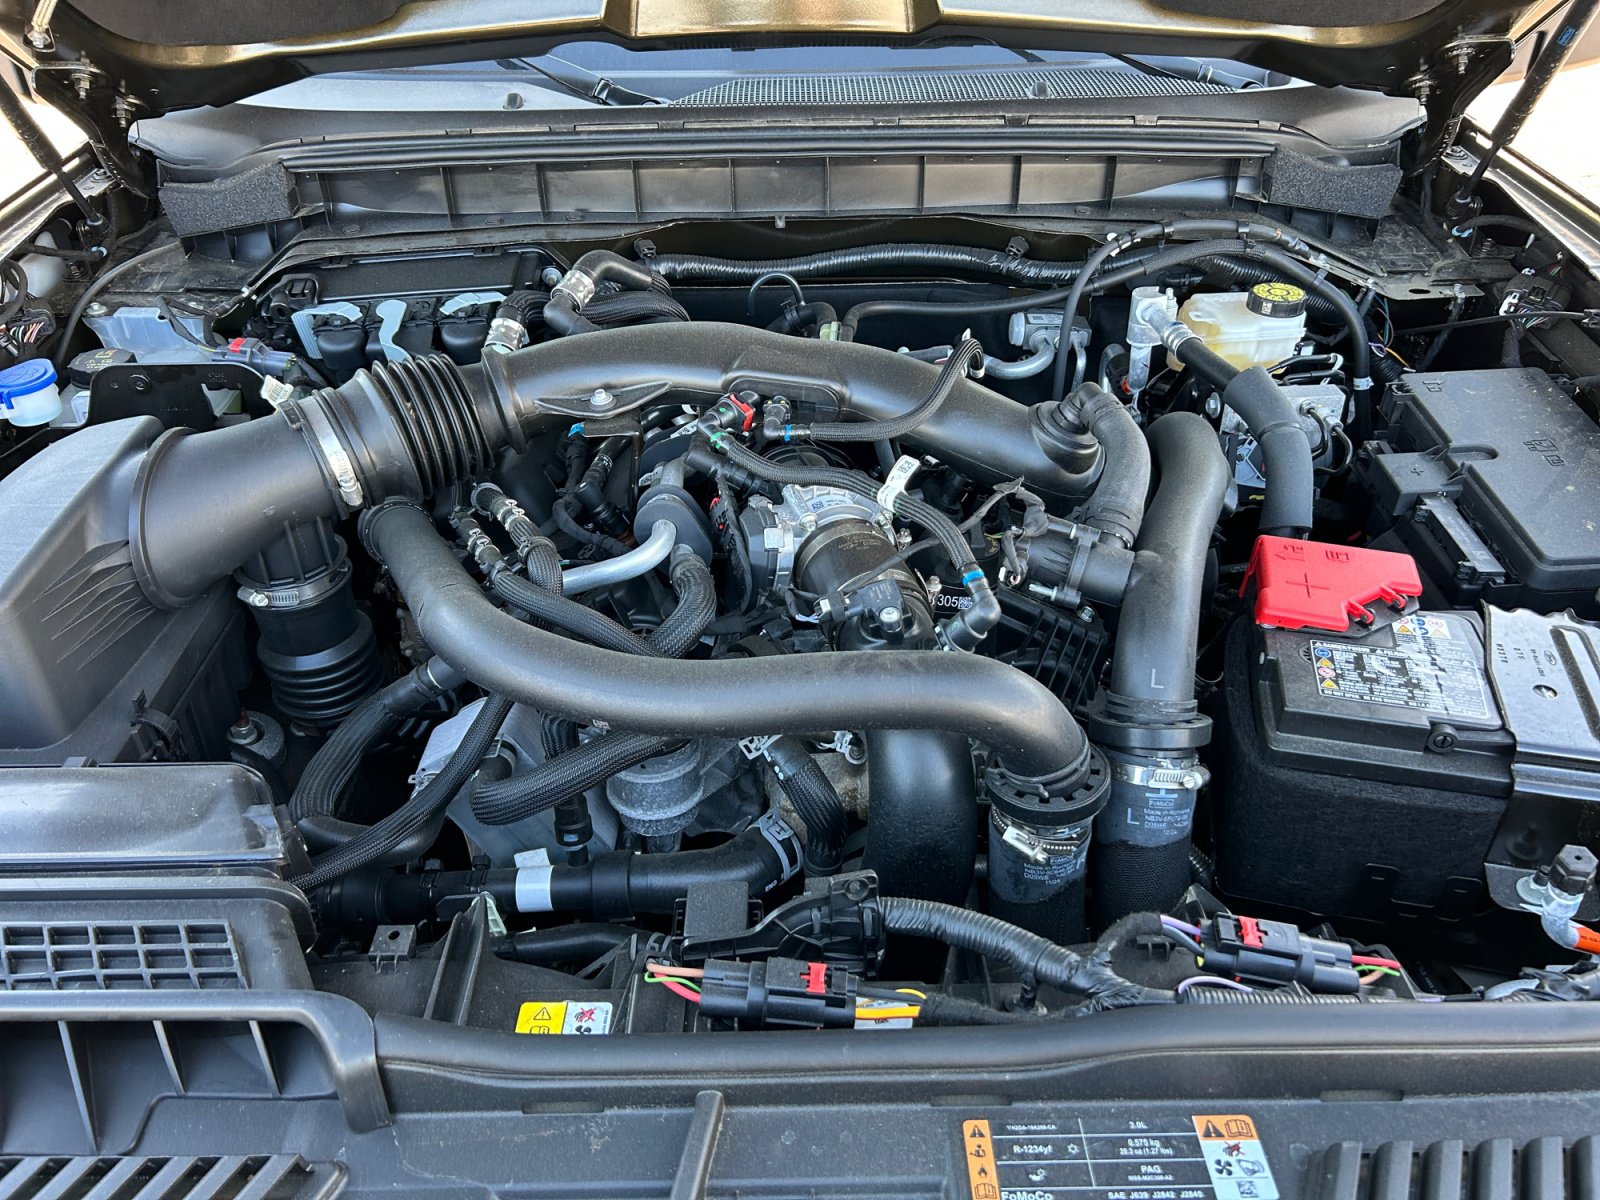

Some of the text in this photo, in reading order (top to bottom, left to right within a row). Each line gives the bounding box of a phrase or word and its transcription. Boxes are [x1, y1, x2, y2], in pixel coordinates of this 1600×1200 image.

[1150, 668, 1164, 689] L
[1127, 807, 1140, 825] L
[1129, 1121, 1148, 1129] 3.0L
[1128, 1138, 1161, 1148] 0.575 kg
[1013, 1144, 1053, 1155] R-1234yf
[1140, 1164, 1162, 1174] PAG
[1001, 1191, 1053, 1200] FoMoCo
[1107, 1191, 1128, 1200] SAE
[1130, 1191, 1150, 1200] J639
